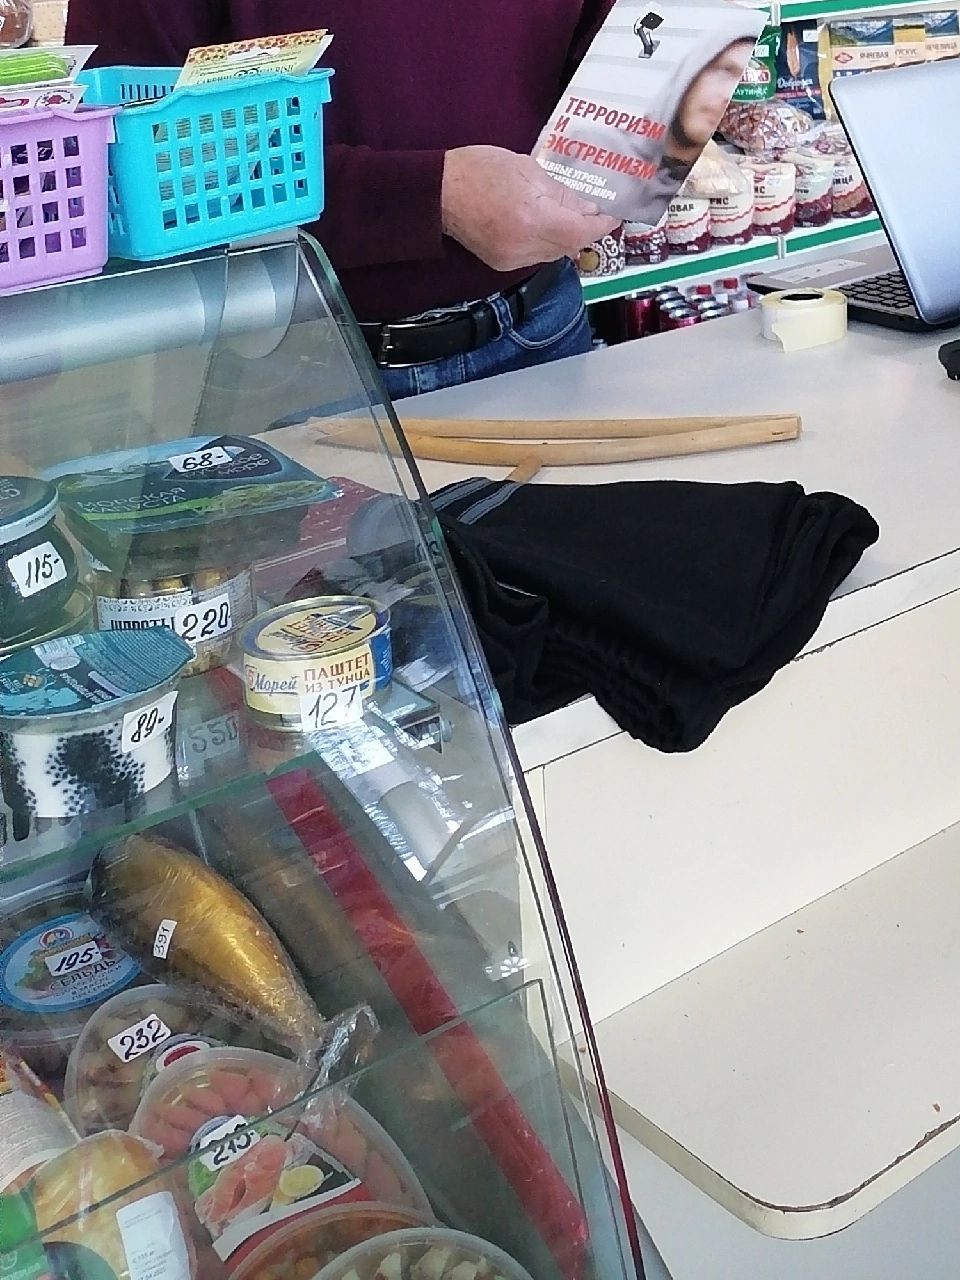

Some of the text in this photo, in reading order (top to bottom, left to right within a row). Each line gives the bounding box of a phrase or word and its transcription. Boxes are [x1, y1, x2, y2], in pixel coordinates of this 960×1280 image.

[553, 115, 571, 133] И
[565, 96, 667, 140] ТЕРРОРИЗМ
[544, 133, 658, 180] ЭКСТРЕМИЗМ
[591, 187, 617, 201] МИРА
[182, 452, 224, 470] 68-
[77, 487, 185, 508] МОРСКАЯ
[25, 553, 60, 588] 115-
[304, 652, 370, 681] ПАШТЕТ
[305, 668, 371, 693] ИЗ ТУНЦА
[254, 675, 297, 696] Морей
[308, 685, 360, 728] 127
[50, 959, 116, 991] СЕЛЬДЬ
[118, 1019, 167, 1062] 232
